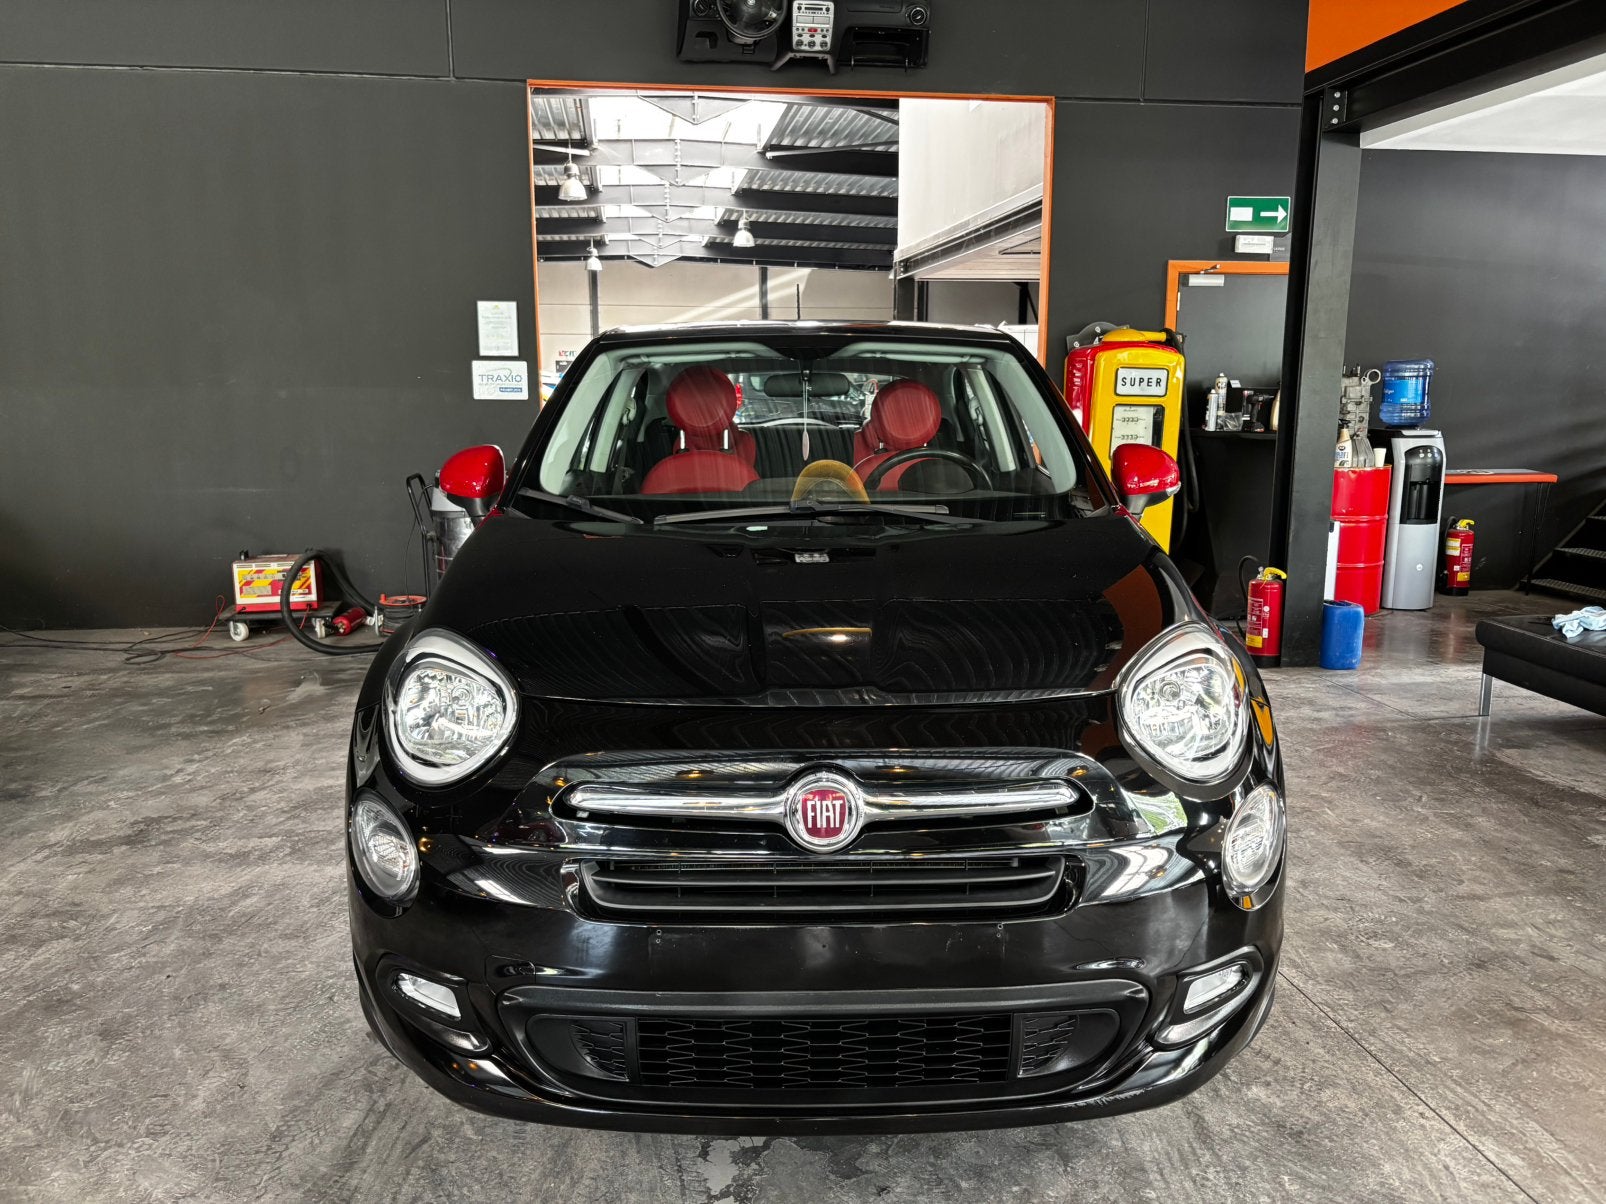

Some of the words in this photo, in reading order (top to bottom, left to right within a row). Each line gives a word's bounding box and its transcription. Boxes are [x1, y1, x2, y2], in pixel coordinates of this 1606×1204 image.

[478, 374, 523, 383] TRAXIO
[1121, 376, 1162, 387] SUPER
[806, 799, 843, 829] FIAT
